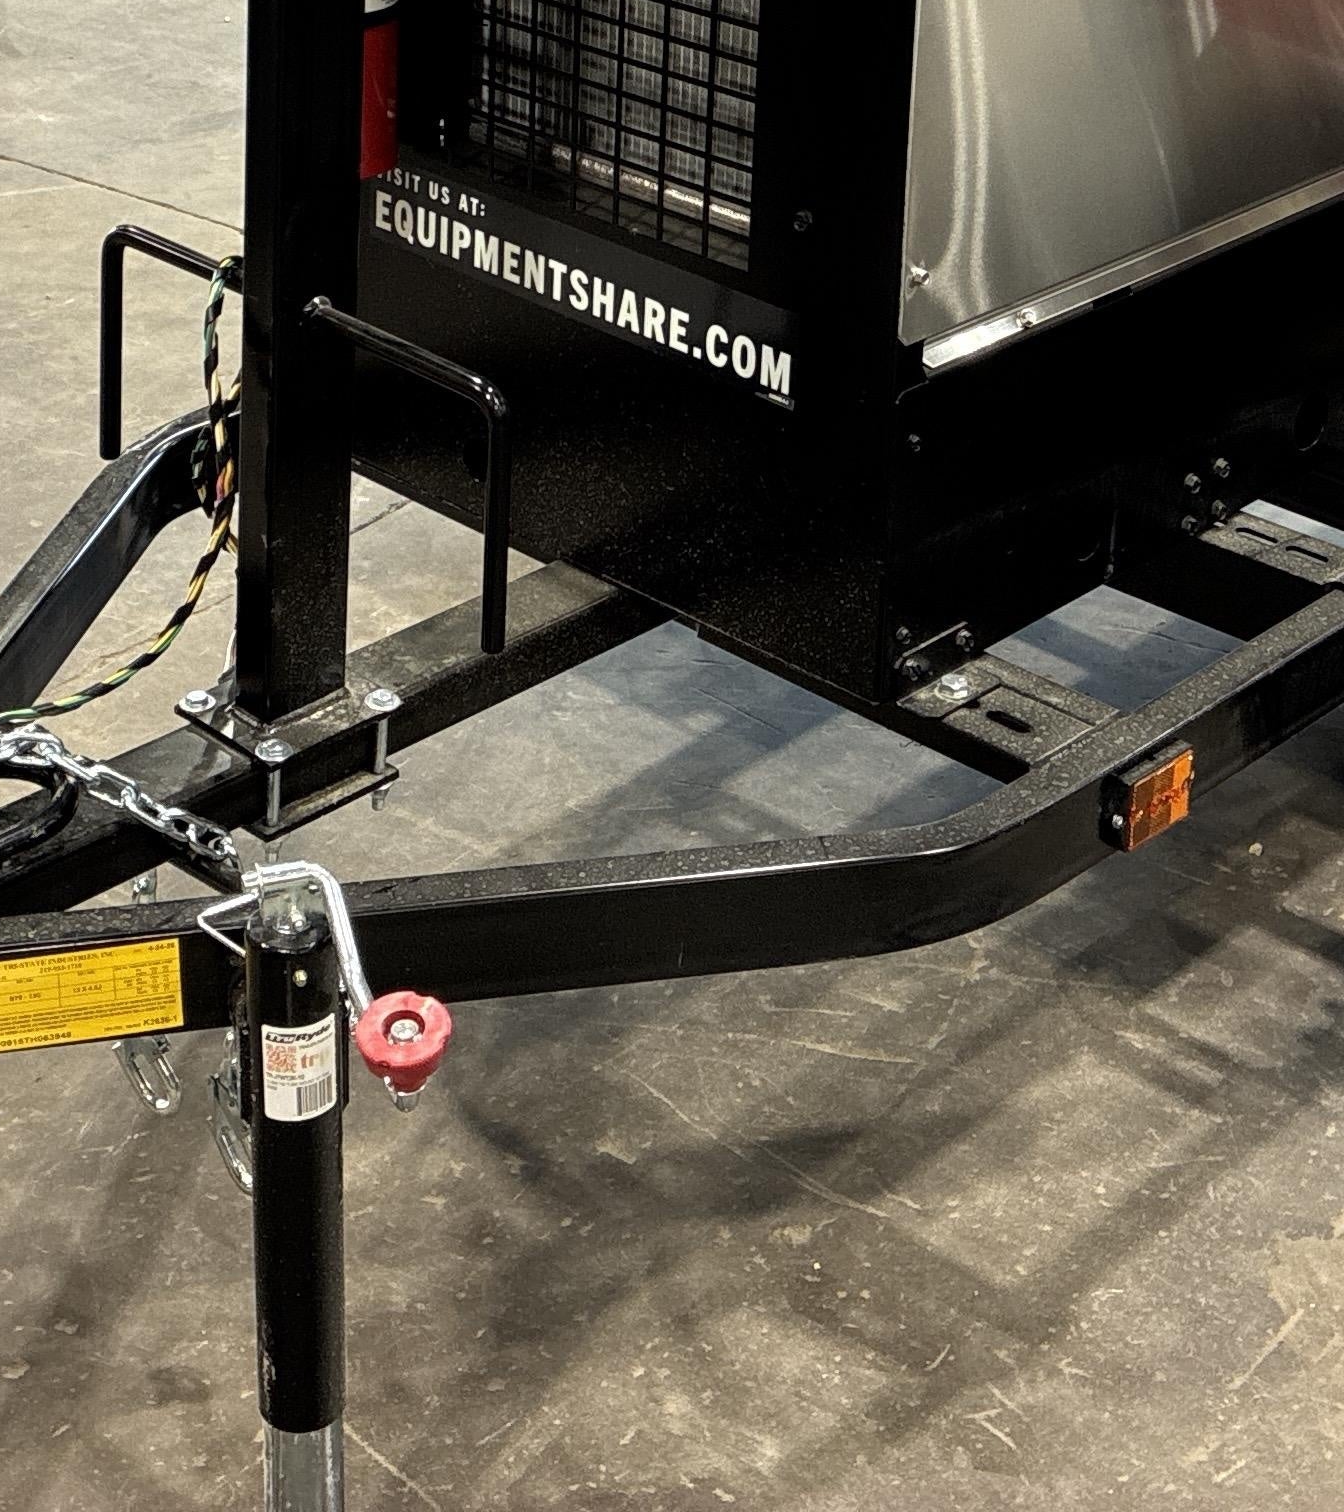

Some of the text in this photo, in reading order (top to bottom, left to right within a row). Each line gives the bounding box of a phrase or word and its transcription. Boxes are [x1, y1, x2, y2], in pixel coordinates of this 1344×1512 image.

[428, 180, 451, 205] US
[458, 193, 486, 217] AT:
[375, 189, 792, 396] EQUIPMENTSHARE.COM
